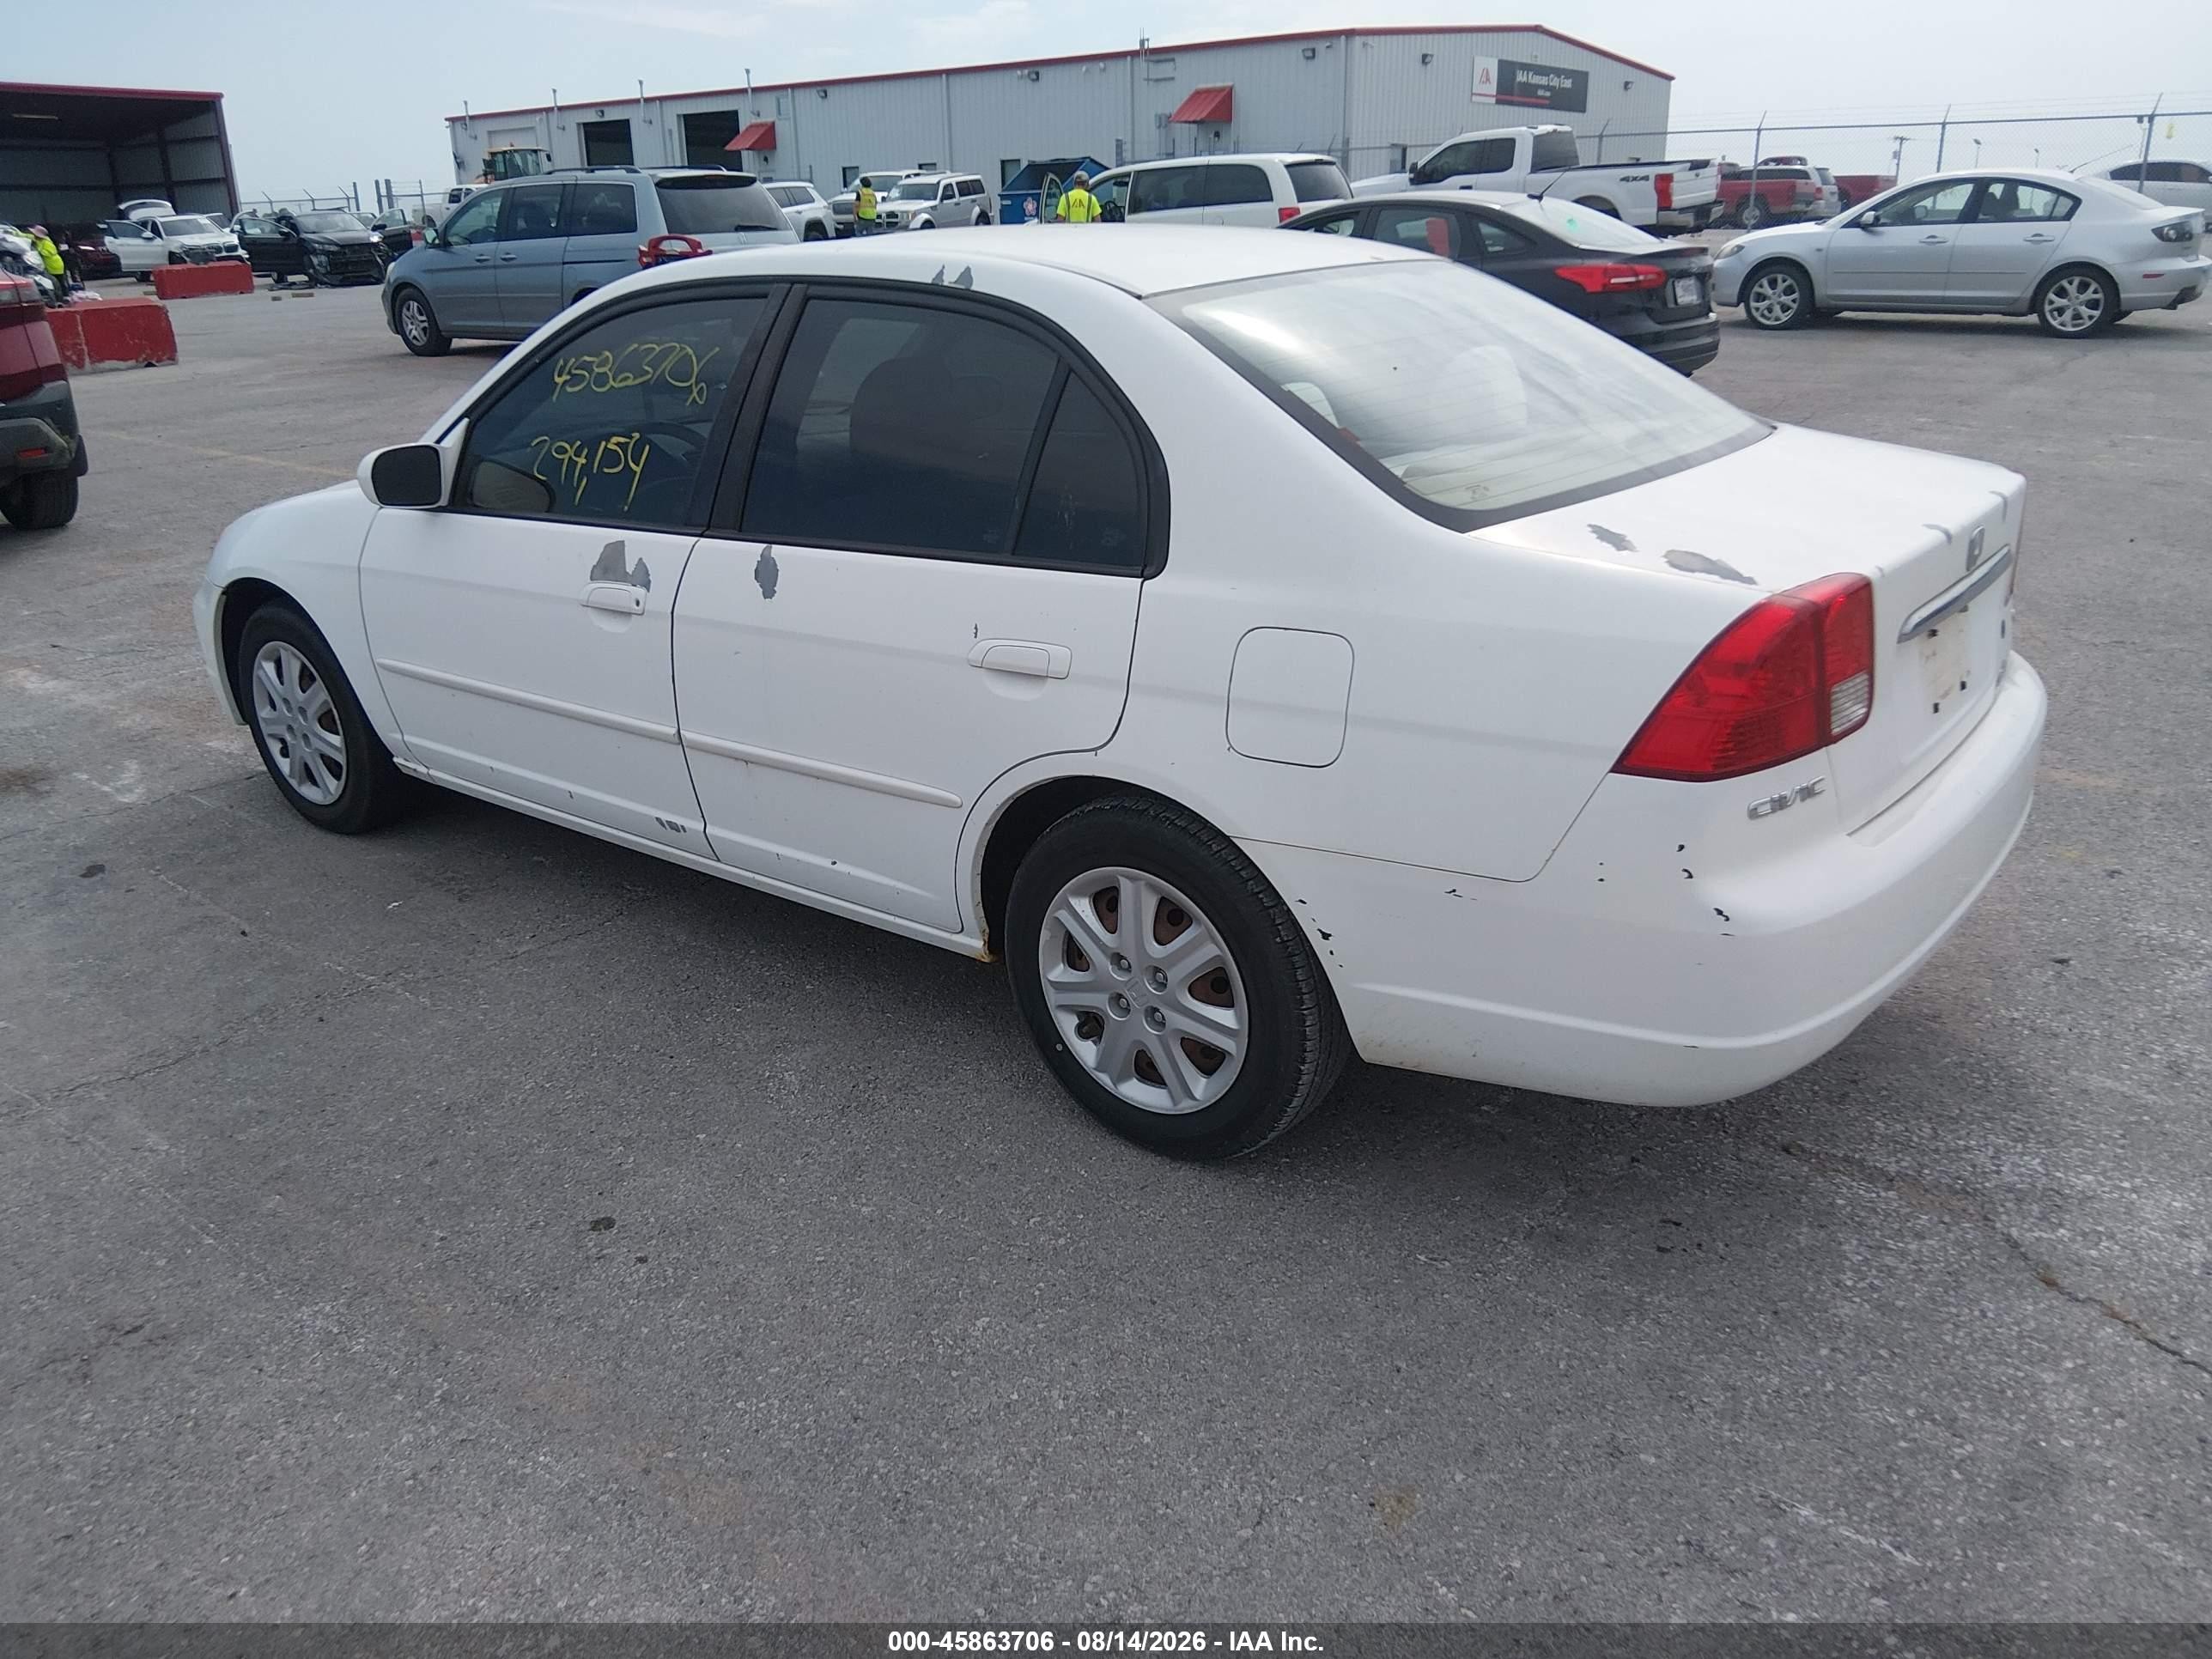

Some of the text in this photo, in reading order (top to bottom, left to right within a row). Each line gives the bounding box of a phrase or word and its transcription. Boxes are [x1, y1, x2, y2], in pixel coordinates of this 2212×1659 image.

[1516, 70, 1572, 89] IAA Kansas City East
[531, 432, 650, 512] 294,154
[1747, 775, 1826, 821] CIVIC
